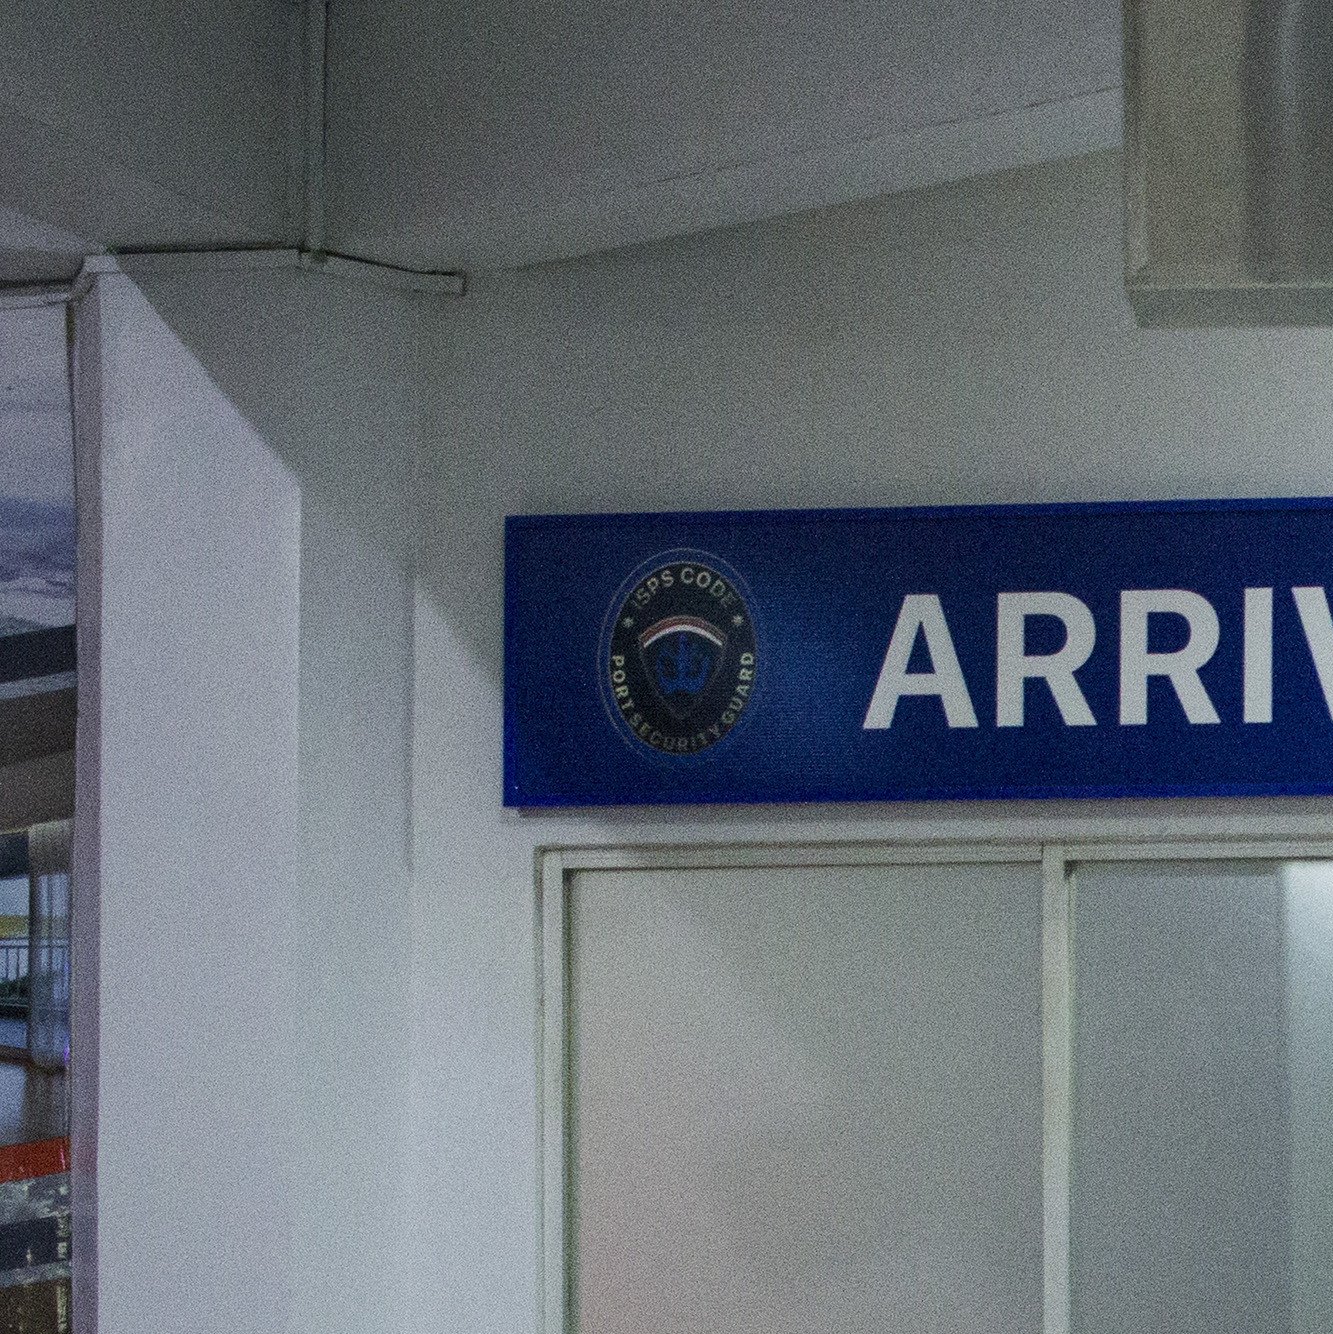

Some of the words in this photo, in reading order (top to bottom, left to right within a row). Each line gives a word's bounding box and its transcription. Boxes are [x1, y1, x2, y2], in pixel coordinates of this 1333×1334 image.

[680, 567, 739, 607] CODE
[612, 653, 635, 711] PORT
[721, 651, 754, 725] GUARD
